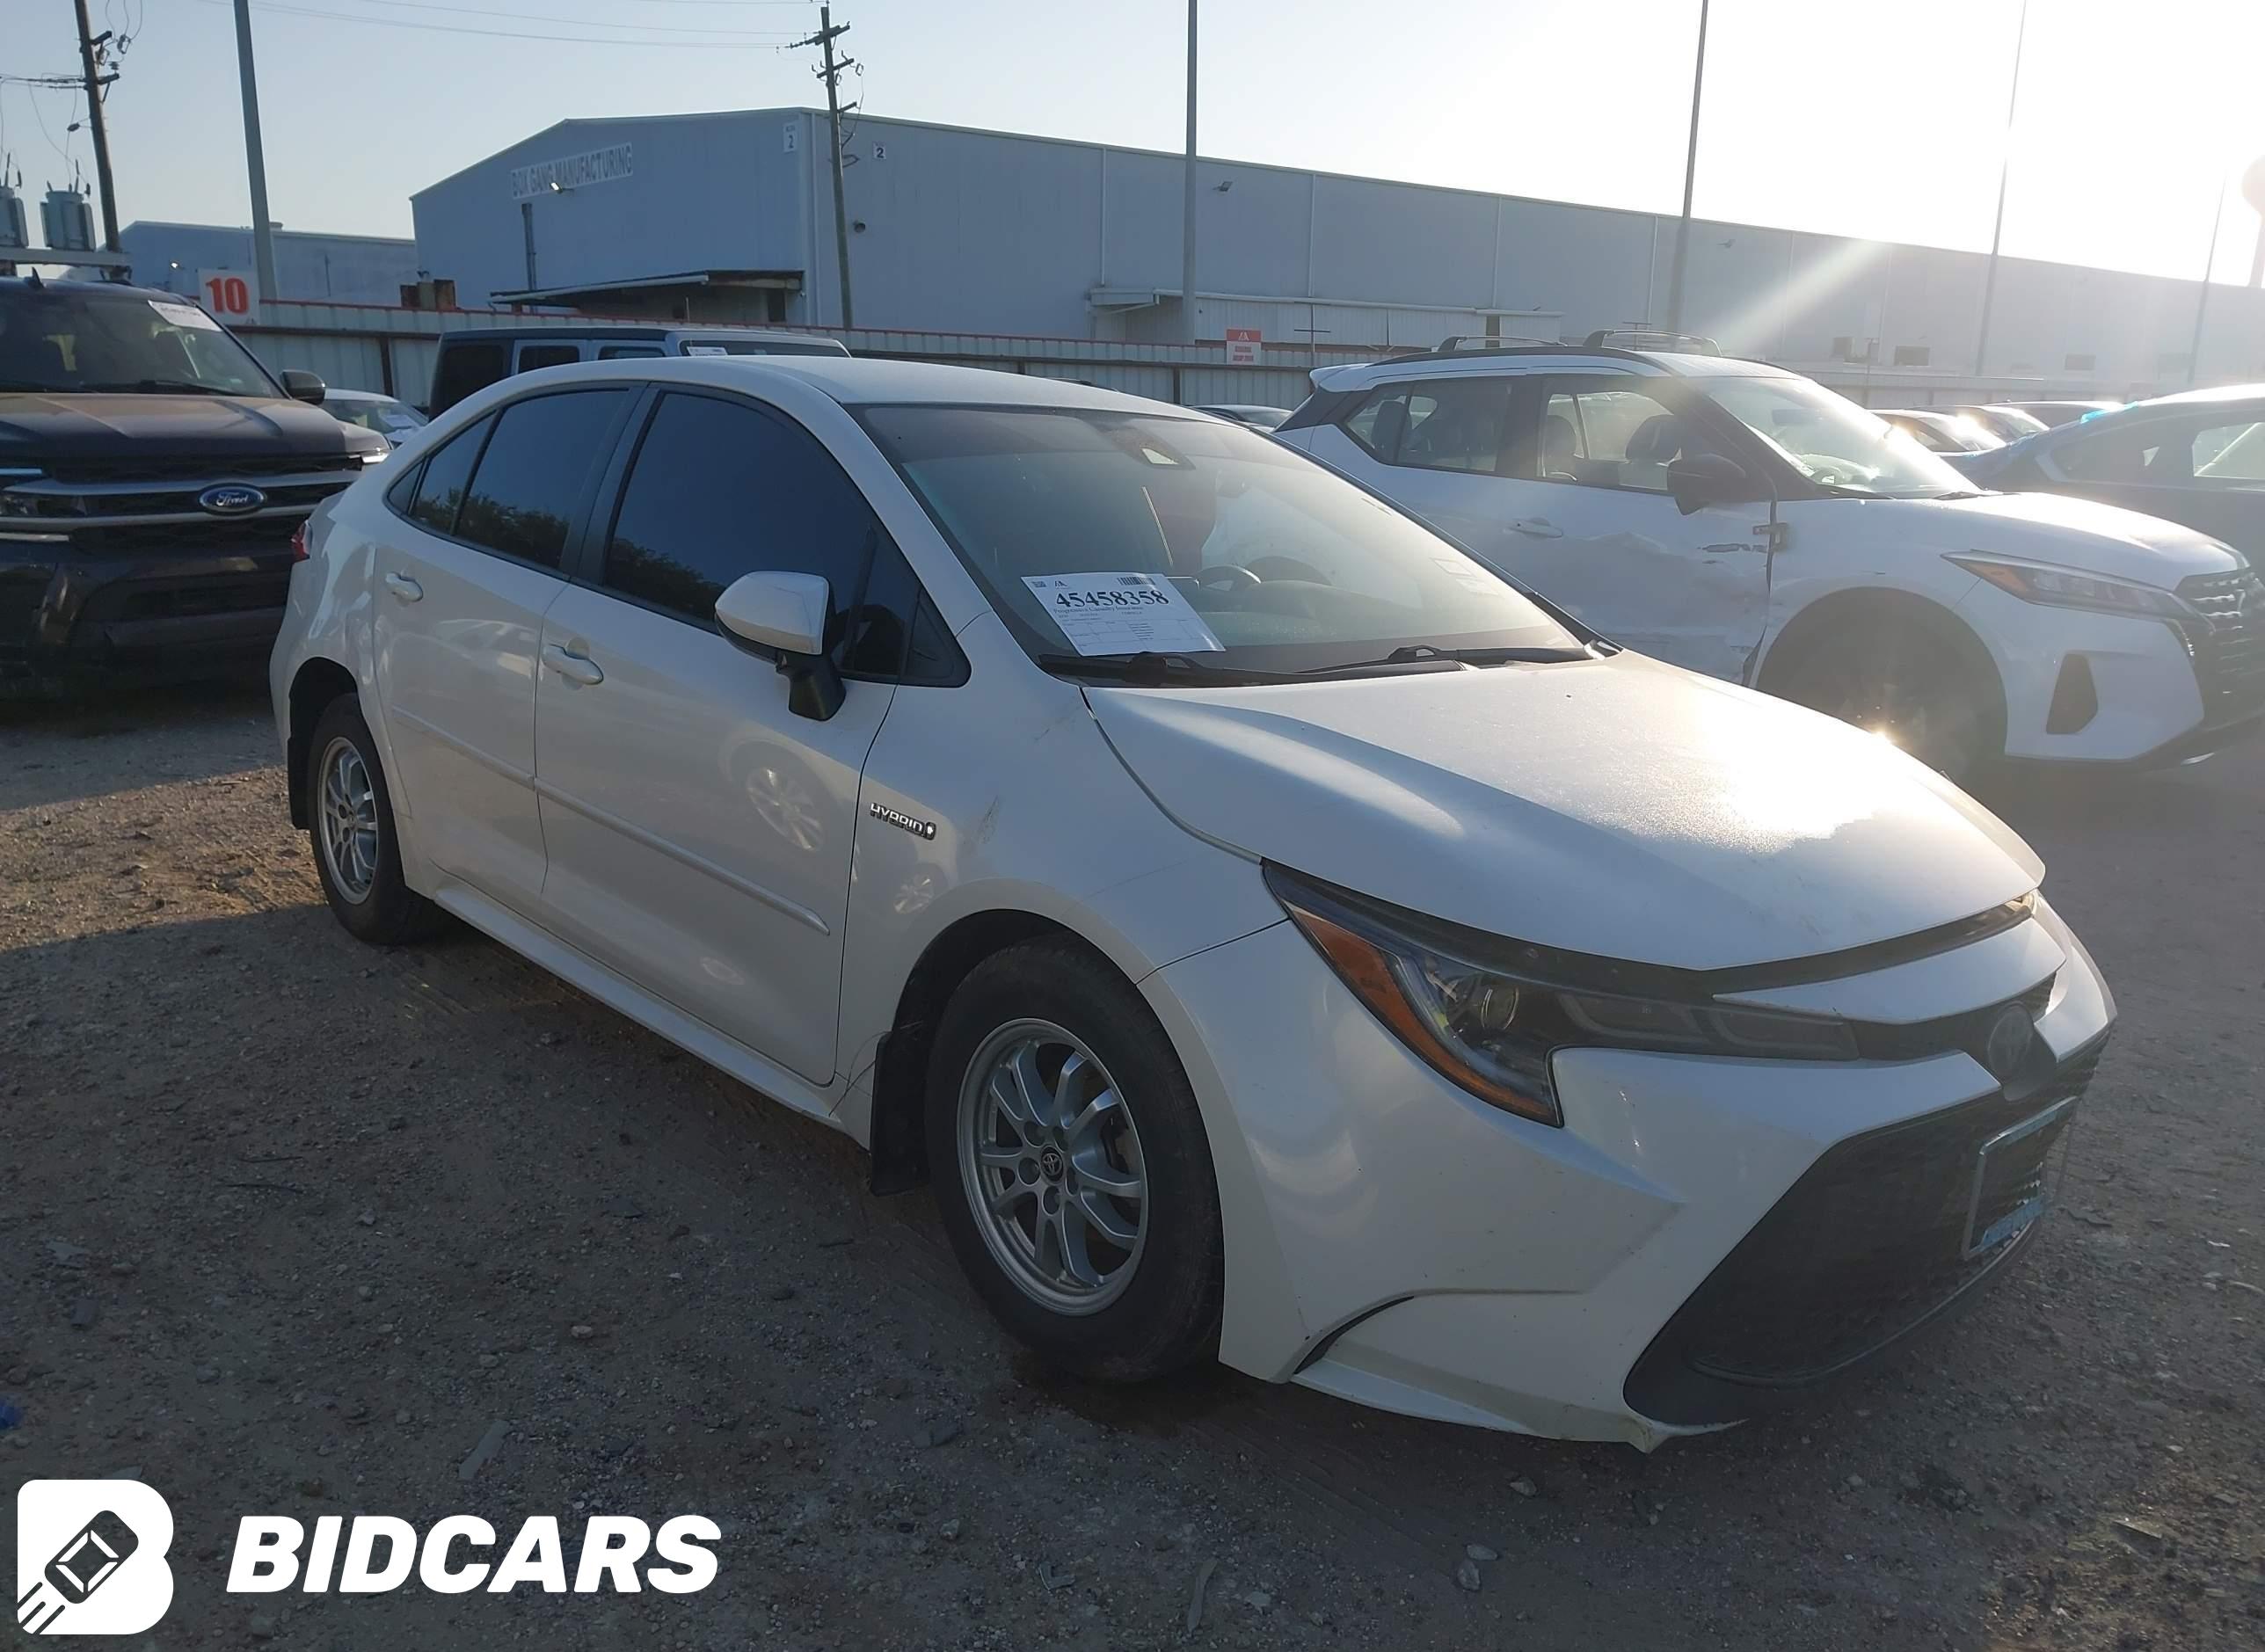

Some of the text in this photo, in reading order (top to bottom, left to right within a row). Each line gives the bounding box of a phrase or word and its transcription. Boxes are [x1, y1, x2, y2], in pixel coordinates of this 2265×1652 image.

[876, 147, 885, 158] 2
[555, 145, 631, 186] MANUFACTURING
[205, 277, 248, 314] 10
[216, 491, 249, 506] Ford
[1056, 590, 1169, 608] 45458358
